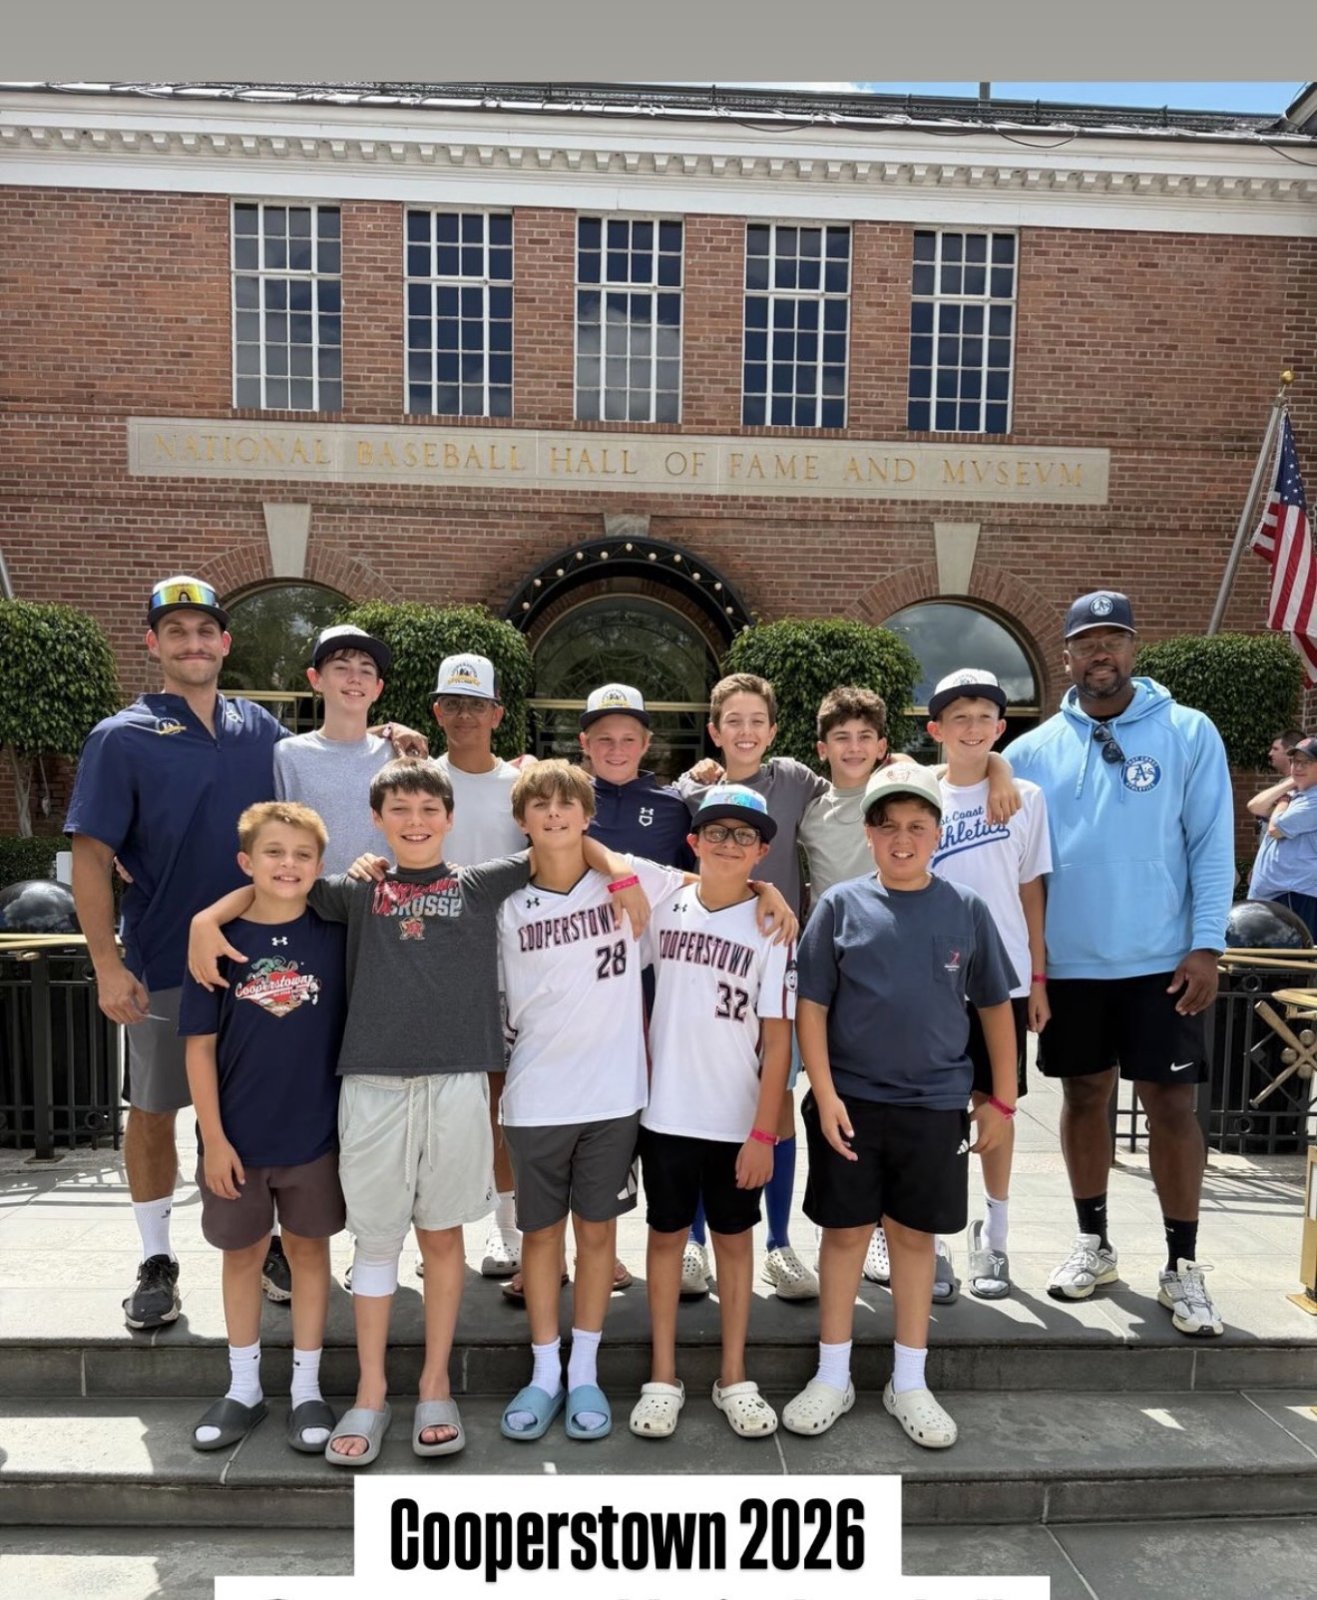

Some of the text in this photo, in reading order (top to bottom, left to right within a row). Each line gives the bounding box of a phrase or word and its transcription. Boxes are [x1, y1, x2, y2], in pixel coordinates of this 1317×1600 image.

[155, 433, 1083, 487] NATIONAL BASEBALL HALL OF FAME AND MVSEVM
[938, 818, 1006, 850] thletic
[952, 805, 984, 821] Coast
[596, 938, 627, 980] 28
[659, 929, 755, 979] COOPERSTOWN
[715, 980, 749, 1023] 32
